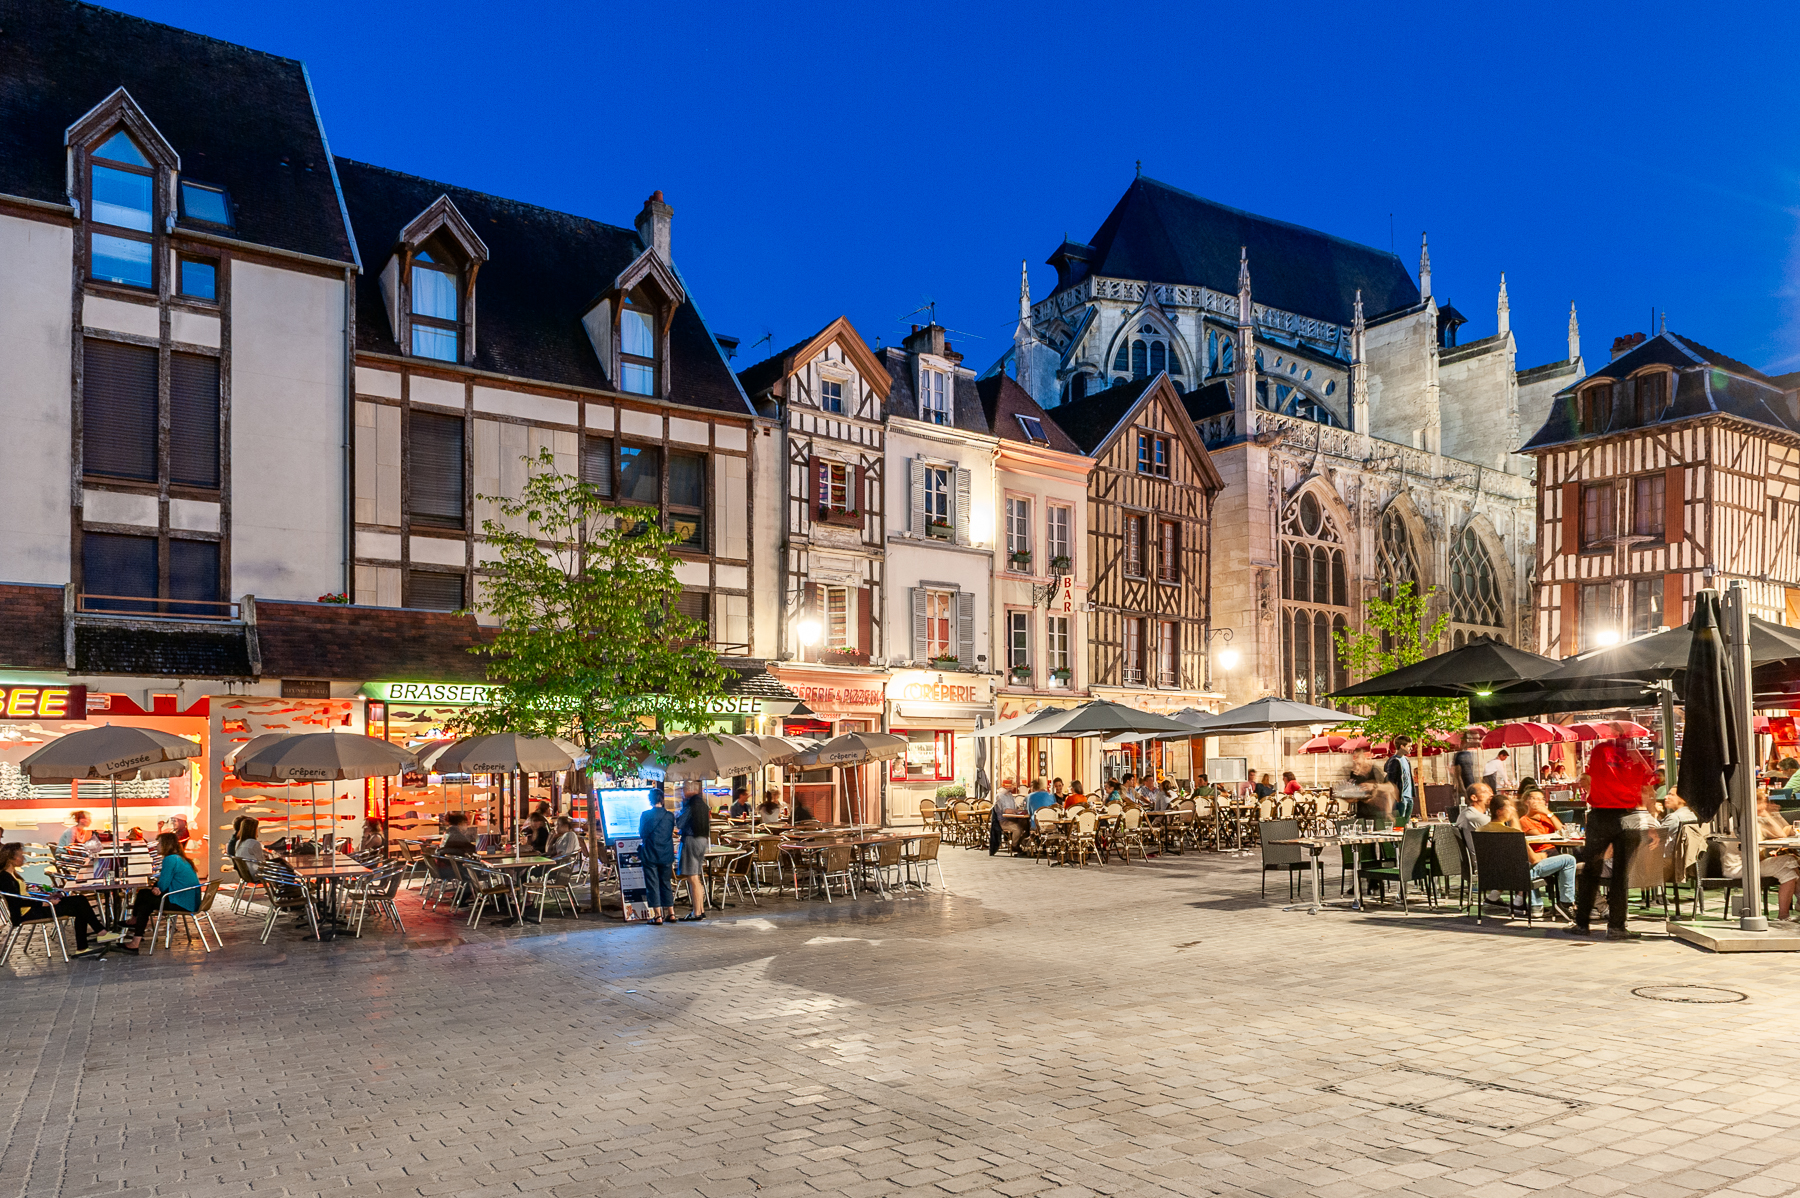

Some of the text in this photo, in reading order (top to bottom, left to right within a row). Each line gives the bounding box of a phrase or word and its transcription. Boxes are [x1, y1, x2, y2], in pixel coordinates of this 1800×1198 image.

[389, 684, 498, 702] BRASSER
[842, 688, 885, 705] PIZZERIA
[904, 682, 977, 702] CRÊPERIE
[0, 689, 70, 716] EE
[106, 754, 150, 771] L'odyssée
[830, 753, 858, 762] Crêperie
[289, 767, 326, 777] Crêperie
[472, 762, 506, 772] Crêperie
[728, 765, 752, 775] Crêperie
